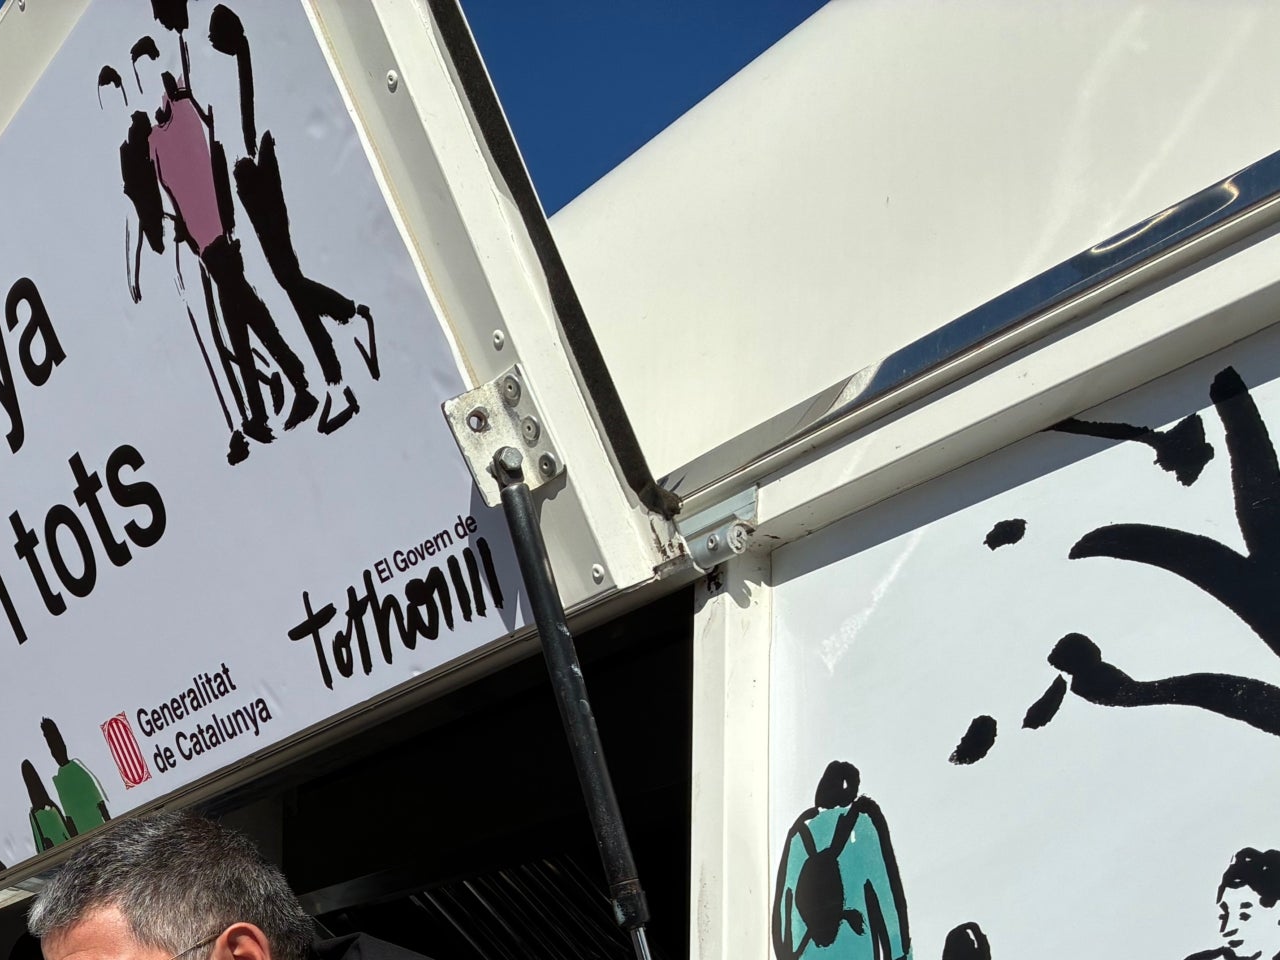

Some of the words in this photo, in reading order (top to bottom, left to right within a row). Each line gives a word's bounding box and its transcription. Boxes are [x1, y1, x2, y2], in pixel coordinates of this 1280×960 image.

[9, 445, 167, 616] tots
[374, 558, 394, 583] El
[393, 529, 453, 573] Govern
[454, 514, 478, 540] de
[136, 662, 237, 738] Generalitat
[153, 743, 176, 773] de
[175, 697, 273, 761] Catalunya
